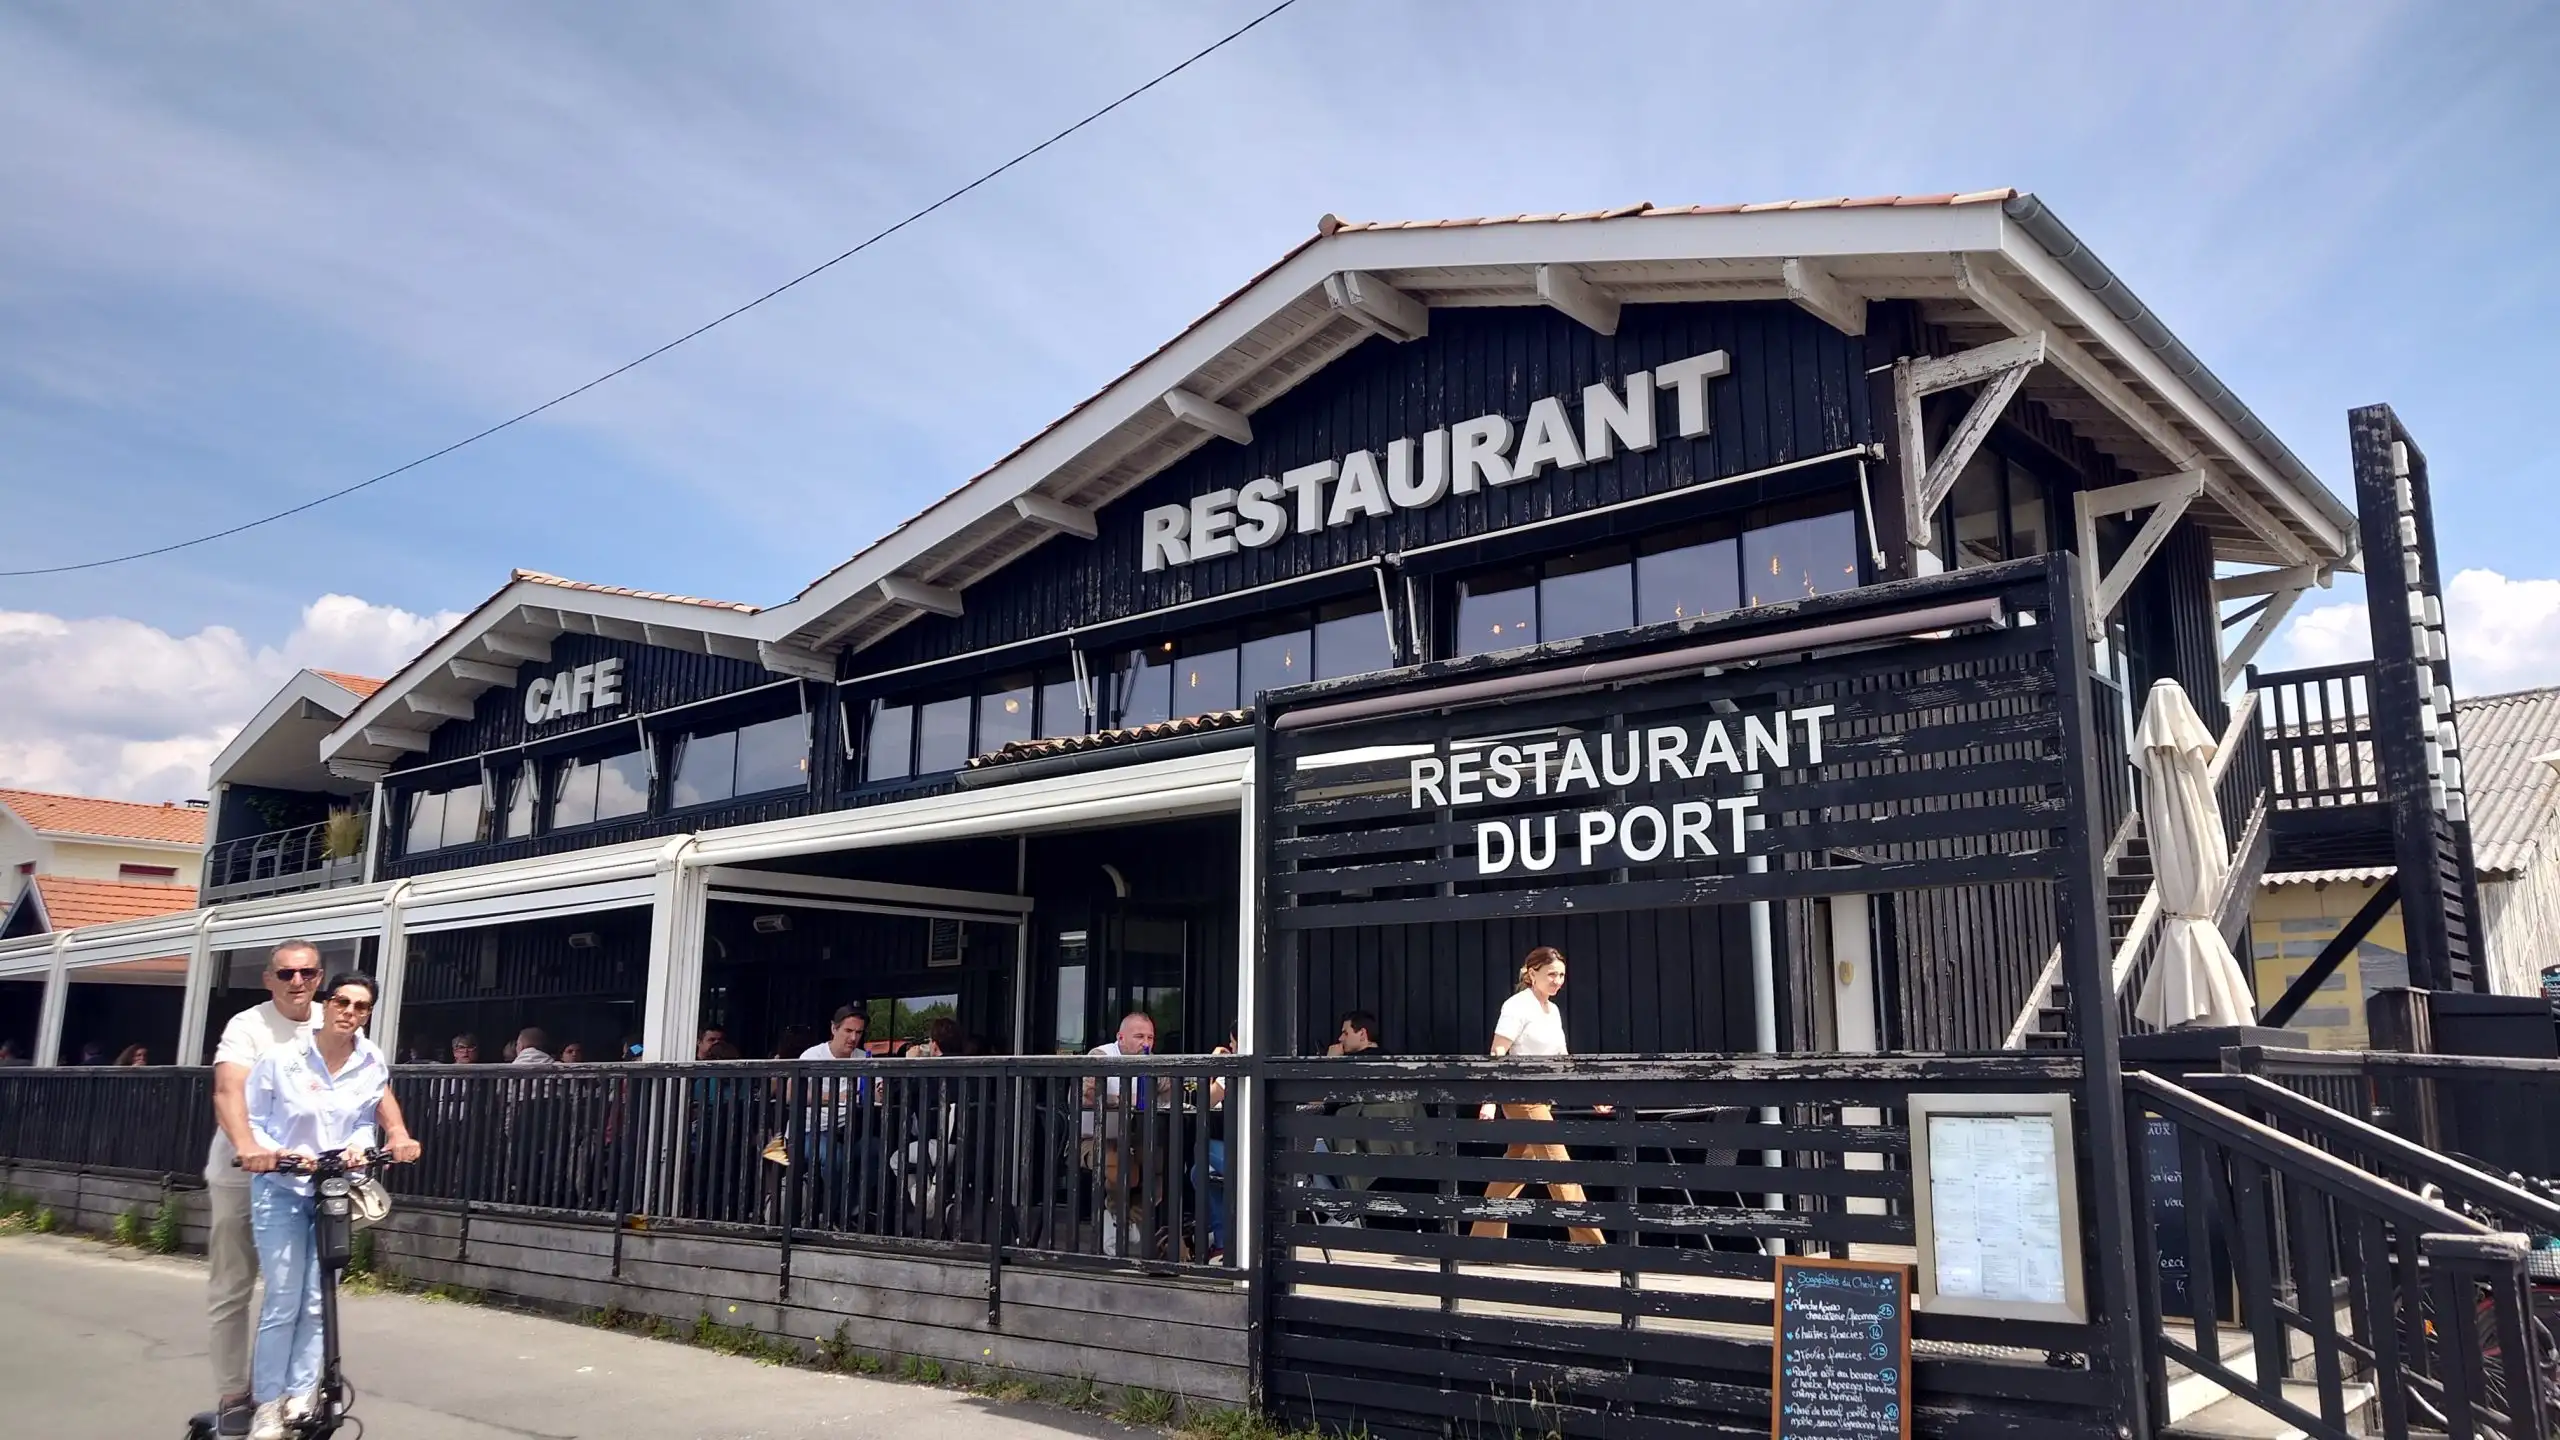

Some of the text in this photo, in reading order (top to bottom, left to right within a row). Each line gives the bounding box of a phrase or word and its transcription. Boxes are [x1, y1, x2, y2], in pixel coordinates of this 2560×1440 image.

[1142, 349, 1730, 573] RESTAURANT
[525, 657, 624, 724] CAFE
[1411, 704, 1835, 809] RESTAURANT
[1477, 796, 1759, 874] DU PORT
[1795, 1327, 1800, 1339] 6
[1872, 1345, 1886, 1358] 13
